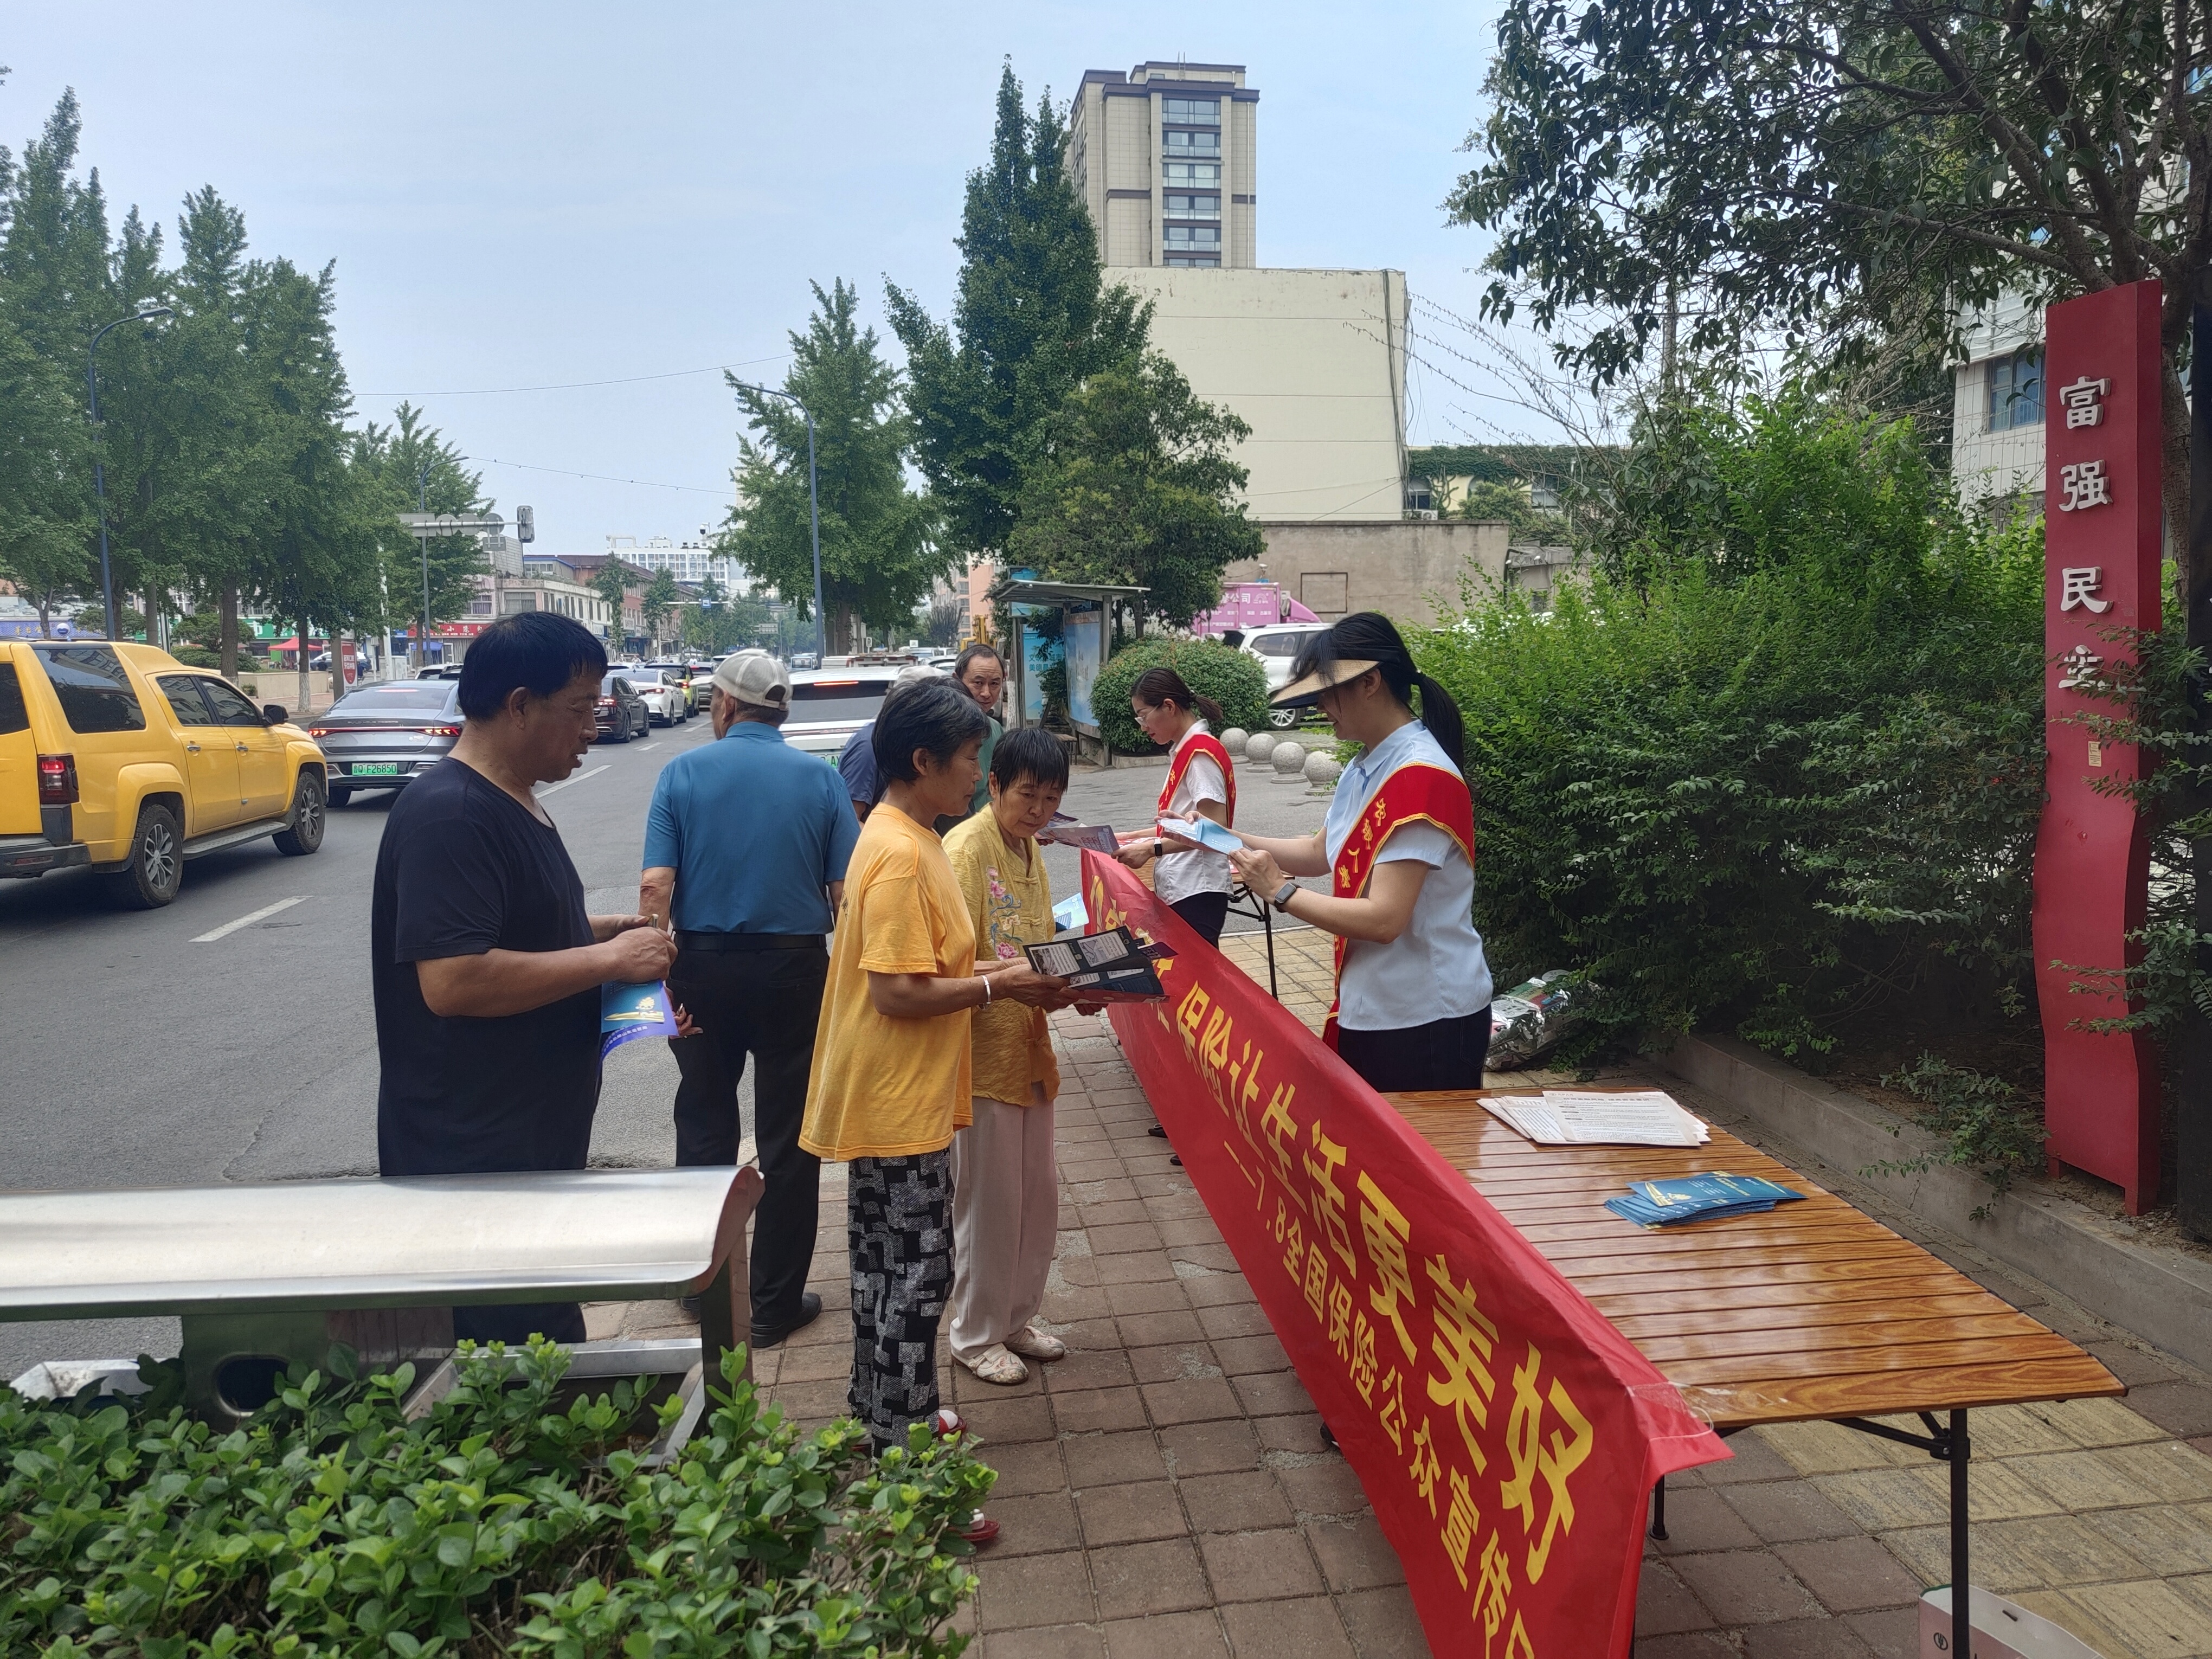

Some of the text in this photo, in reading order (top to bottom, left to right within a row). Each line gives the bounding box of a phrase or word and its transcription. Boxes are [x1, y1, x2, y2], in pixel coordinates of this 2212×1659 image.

[2058, 376, 2114, 692] 富强民主
[1090, 874, 1593, 1585] 保险让生活更美好
